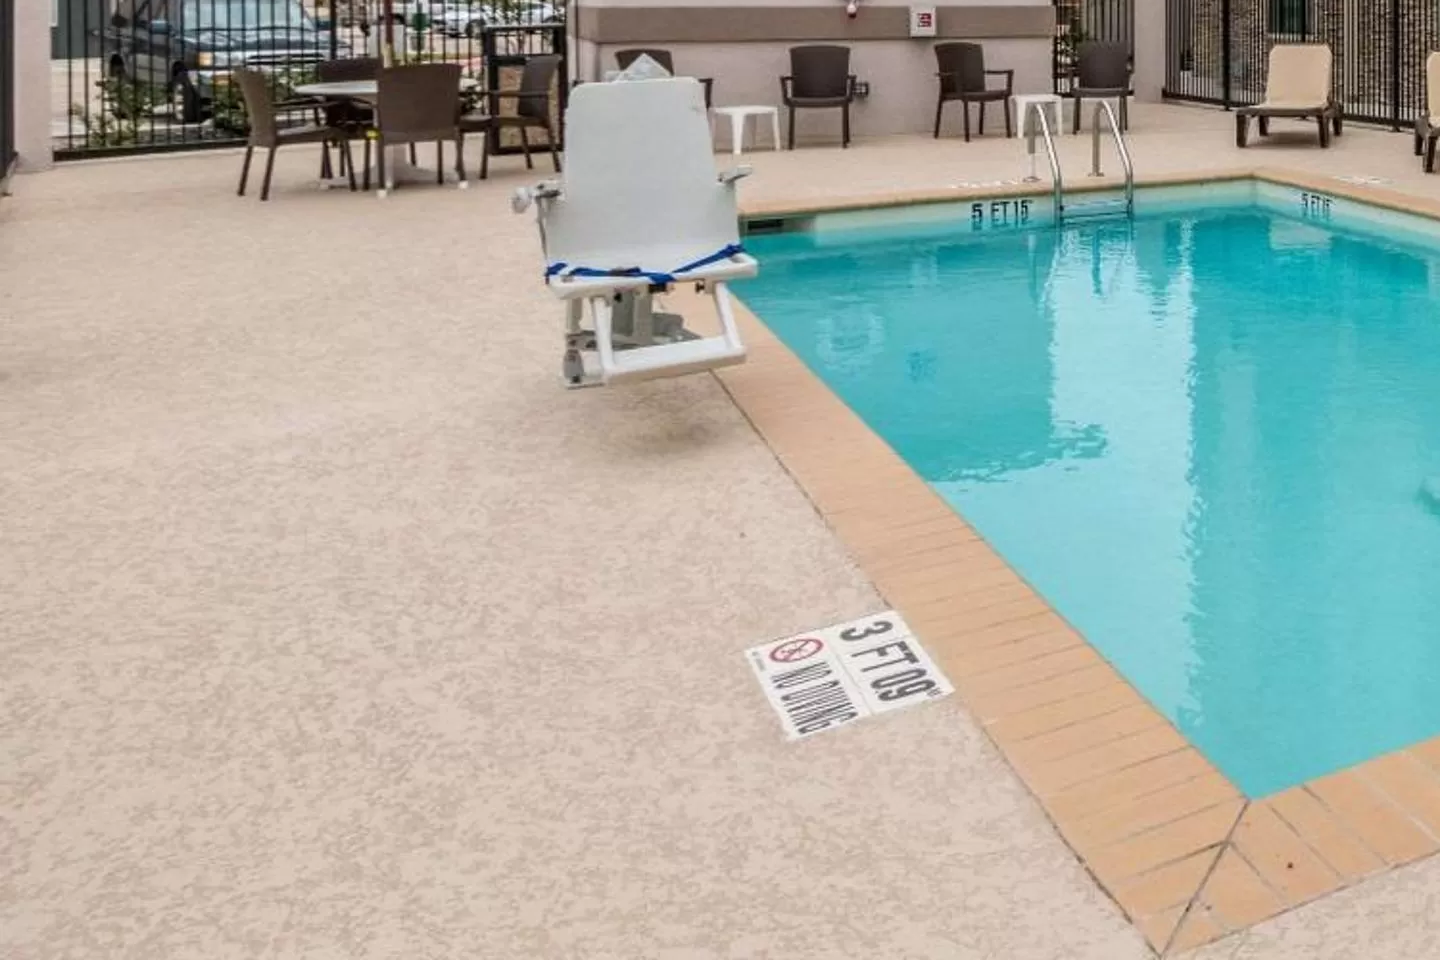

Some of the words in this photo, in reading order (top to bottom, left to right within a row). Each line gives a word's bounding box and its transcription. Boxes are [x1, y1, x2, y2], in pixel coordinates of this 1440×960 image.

[971, 202, 983, 219] 5
[839, 619, 894, 642] 3
[850, 640, 920, 673] FT
[769, 660, 833, 690] NO
[780, 679, 859, 735] DIVING
